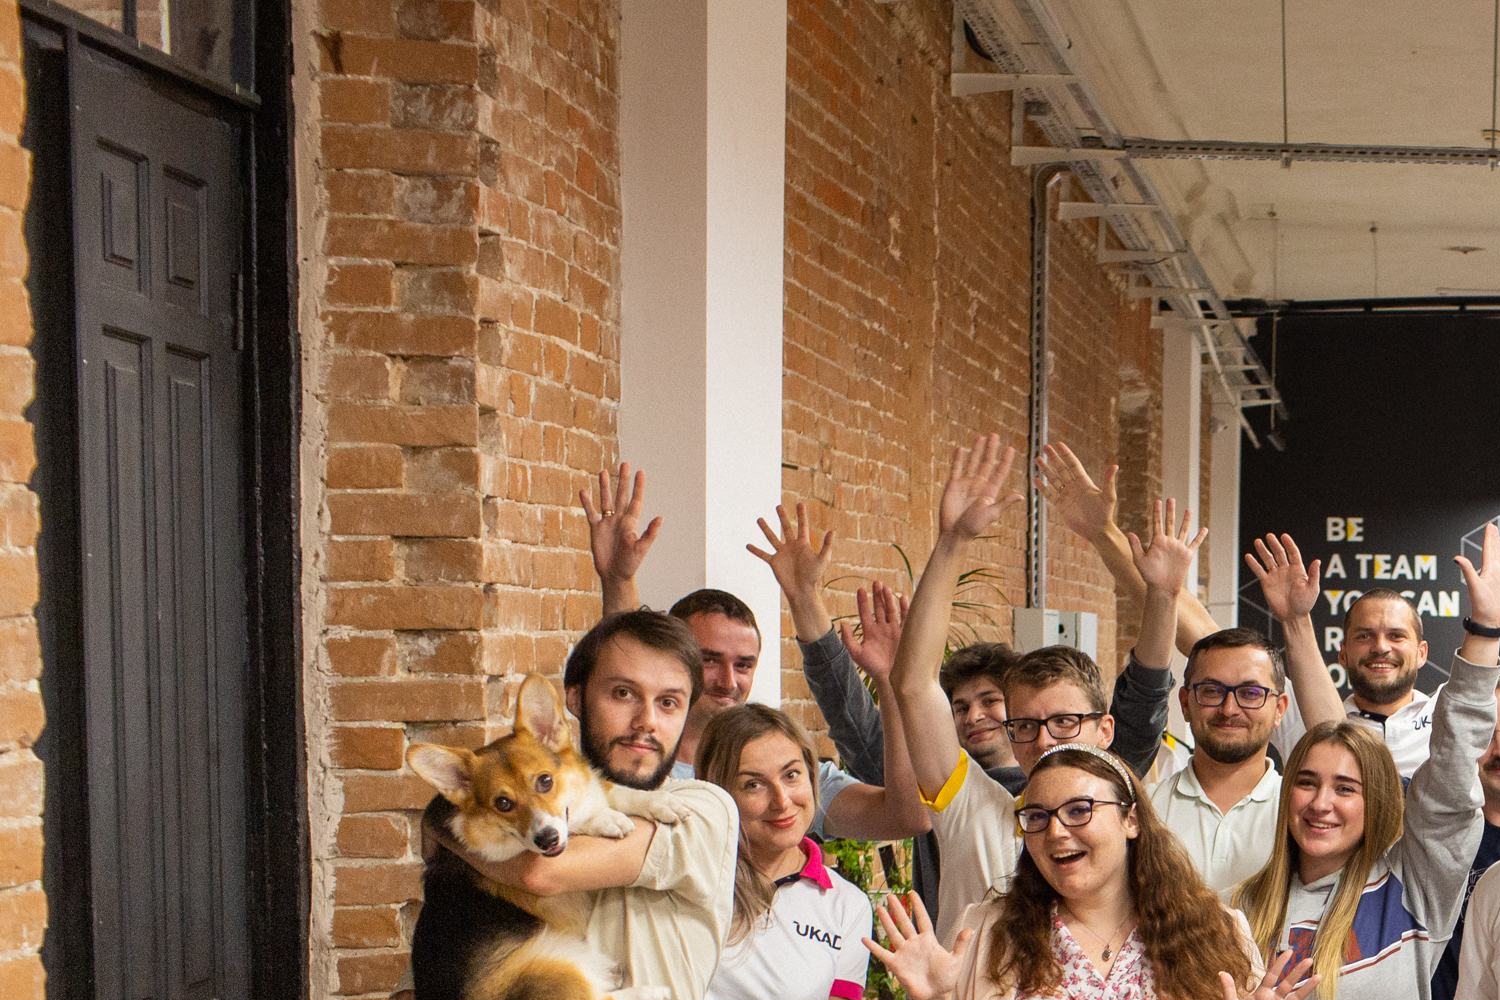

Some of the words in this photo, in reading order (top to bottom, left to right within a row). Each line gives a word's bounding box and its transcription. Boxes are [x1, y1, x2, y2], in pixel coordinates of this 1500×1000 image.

[1326, 517, 1364, 542] BE
[1325, 553, 1347, 579] A
[1355, 554, 1437, 580] TEAM
[1323, 590, 1366, 616] YO
[1412, 715, 1432, 730] UK
